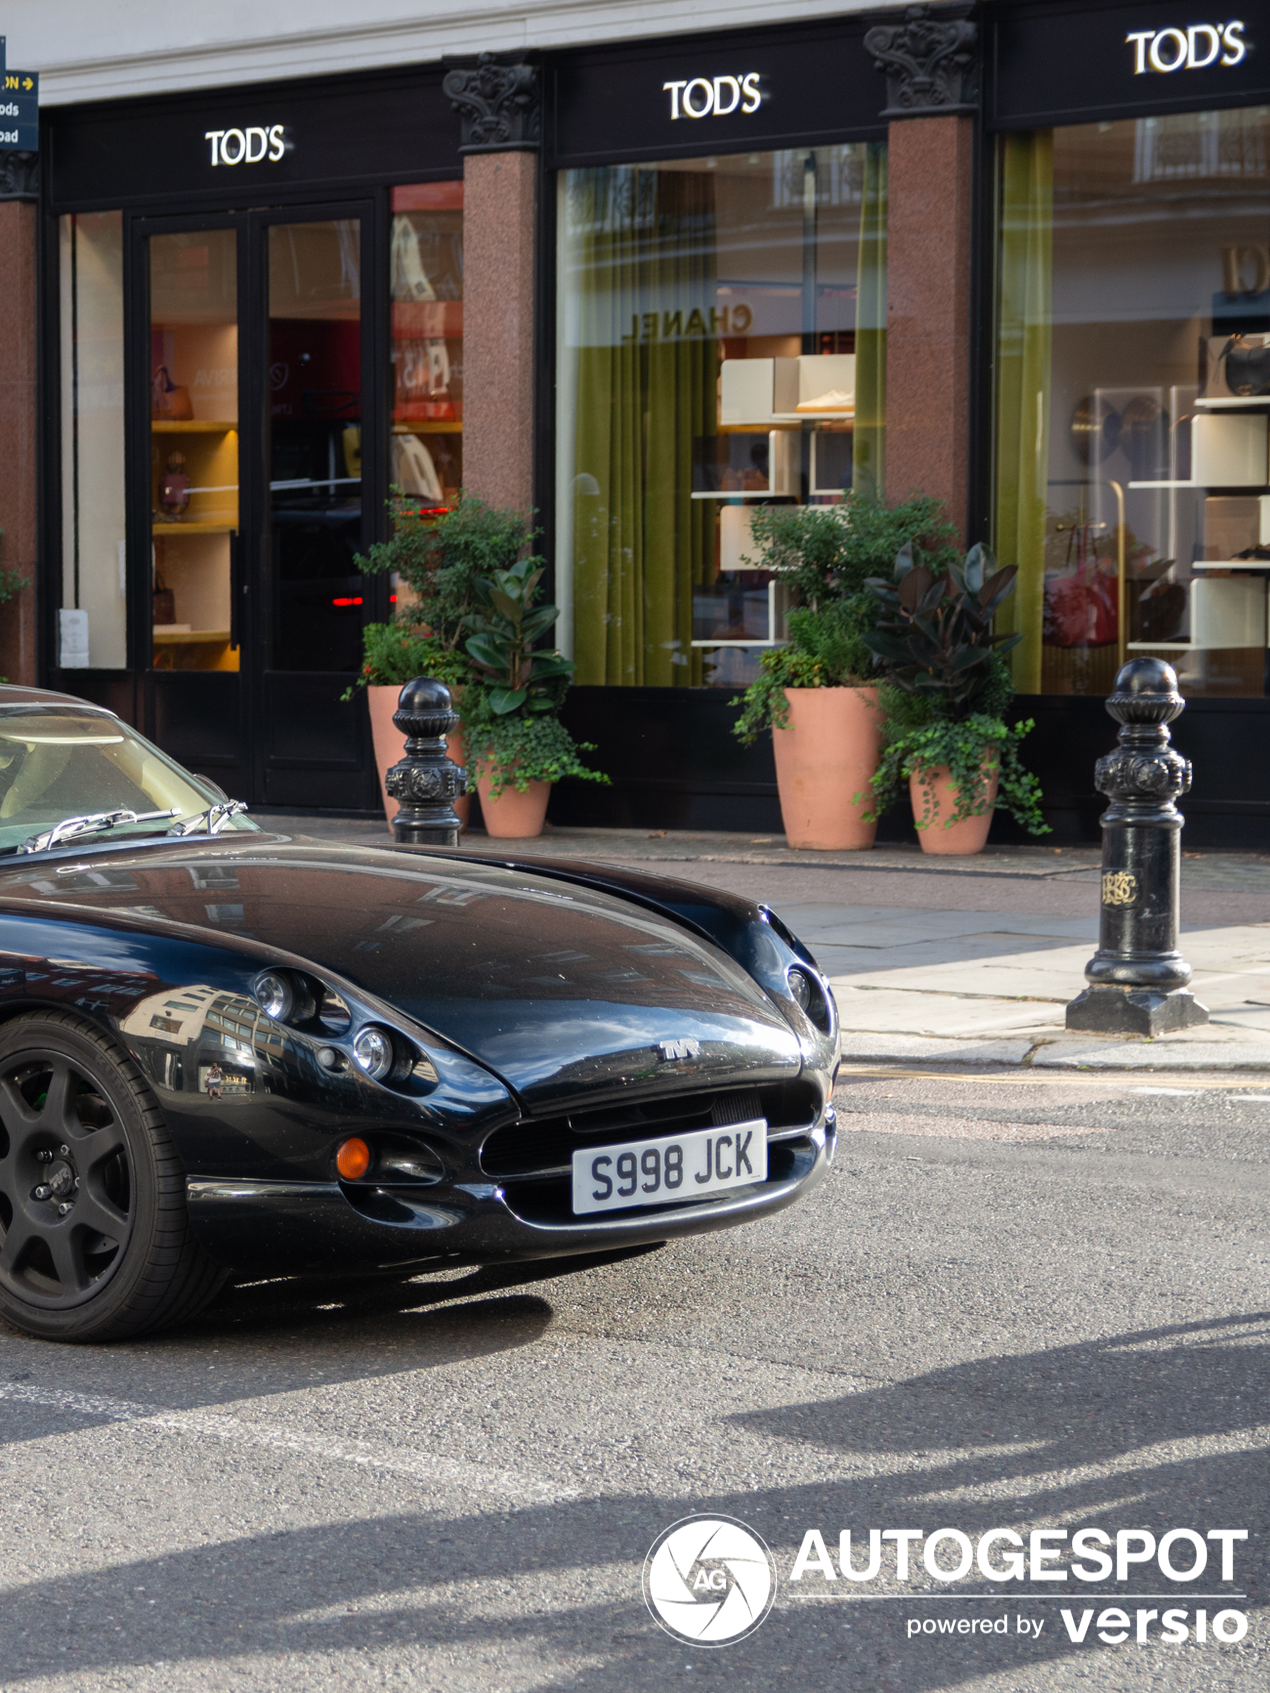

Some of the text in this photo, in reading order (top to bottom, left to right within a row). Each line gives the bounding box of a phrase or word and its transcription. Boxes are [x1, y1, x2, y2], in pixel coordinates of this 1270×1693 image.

[1125, 20, 1246, 75] TOD'S
[662, 72, 761, 120] TOD'S
[204, 124, 286, 166] TOD'S
[591, 1131, 753, 1201] S998 JCK
